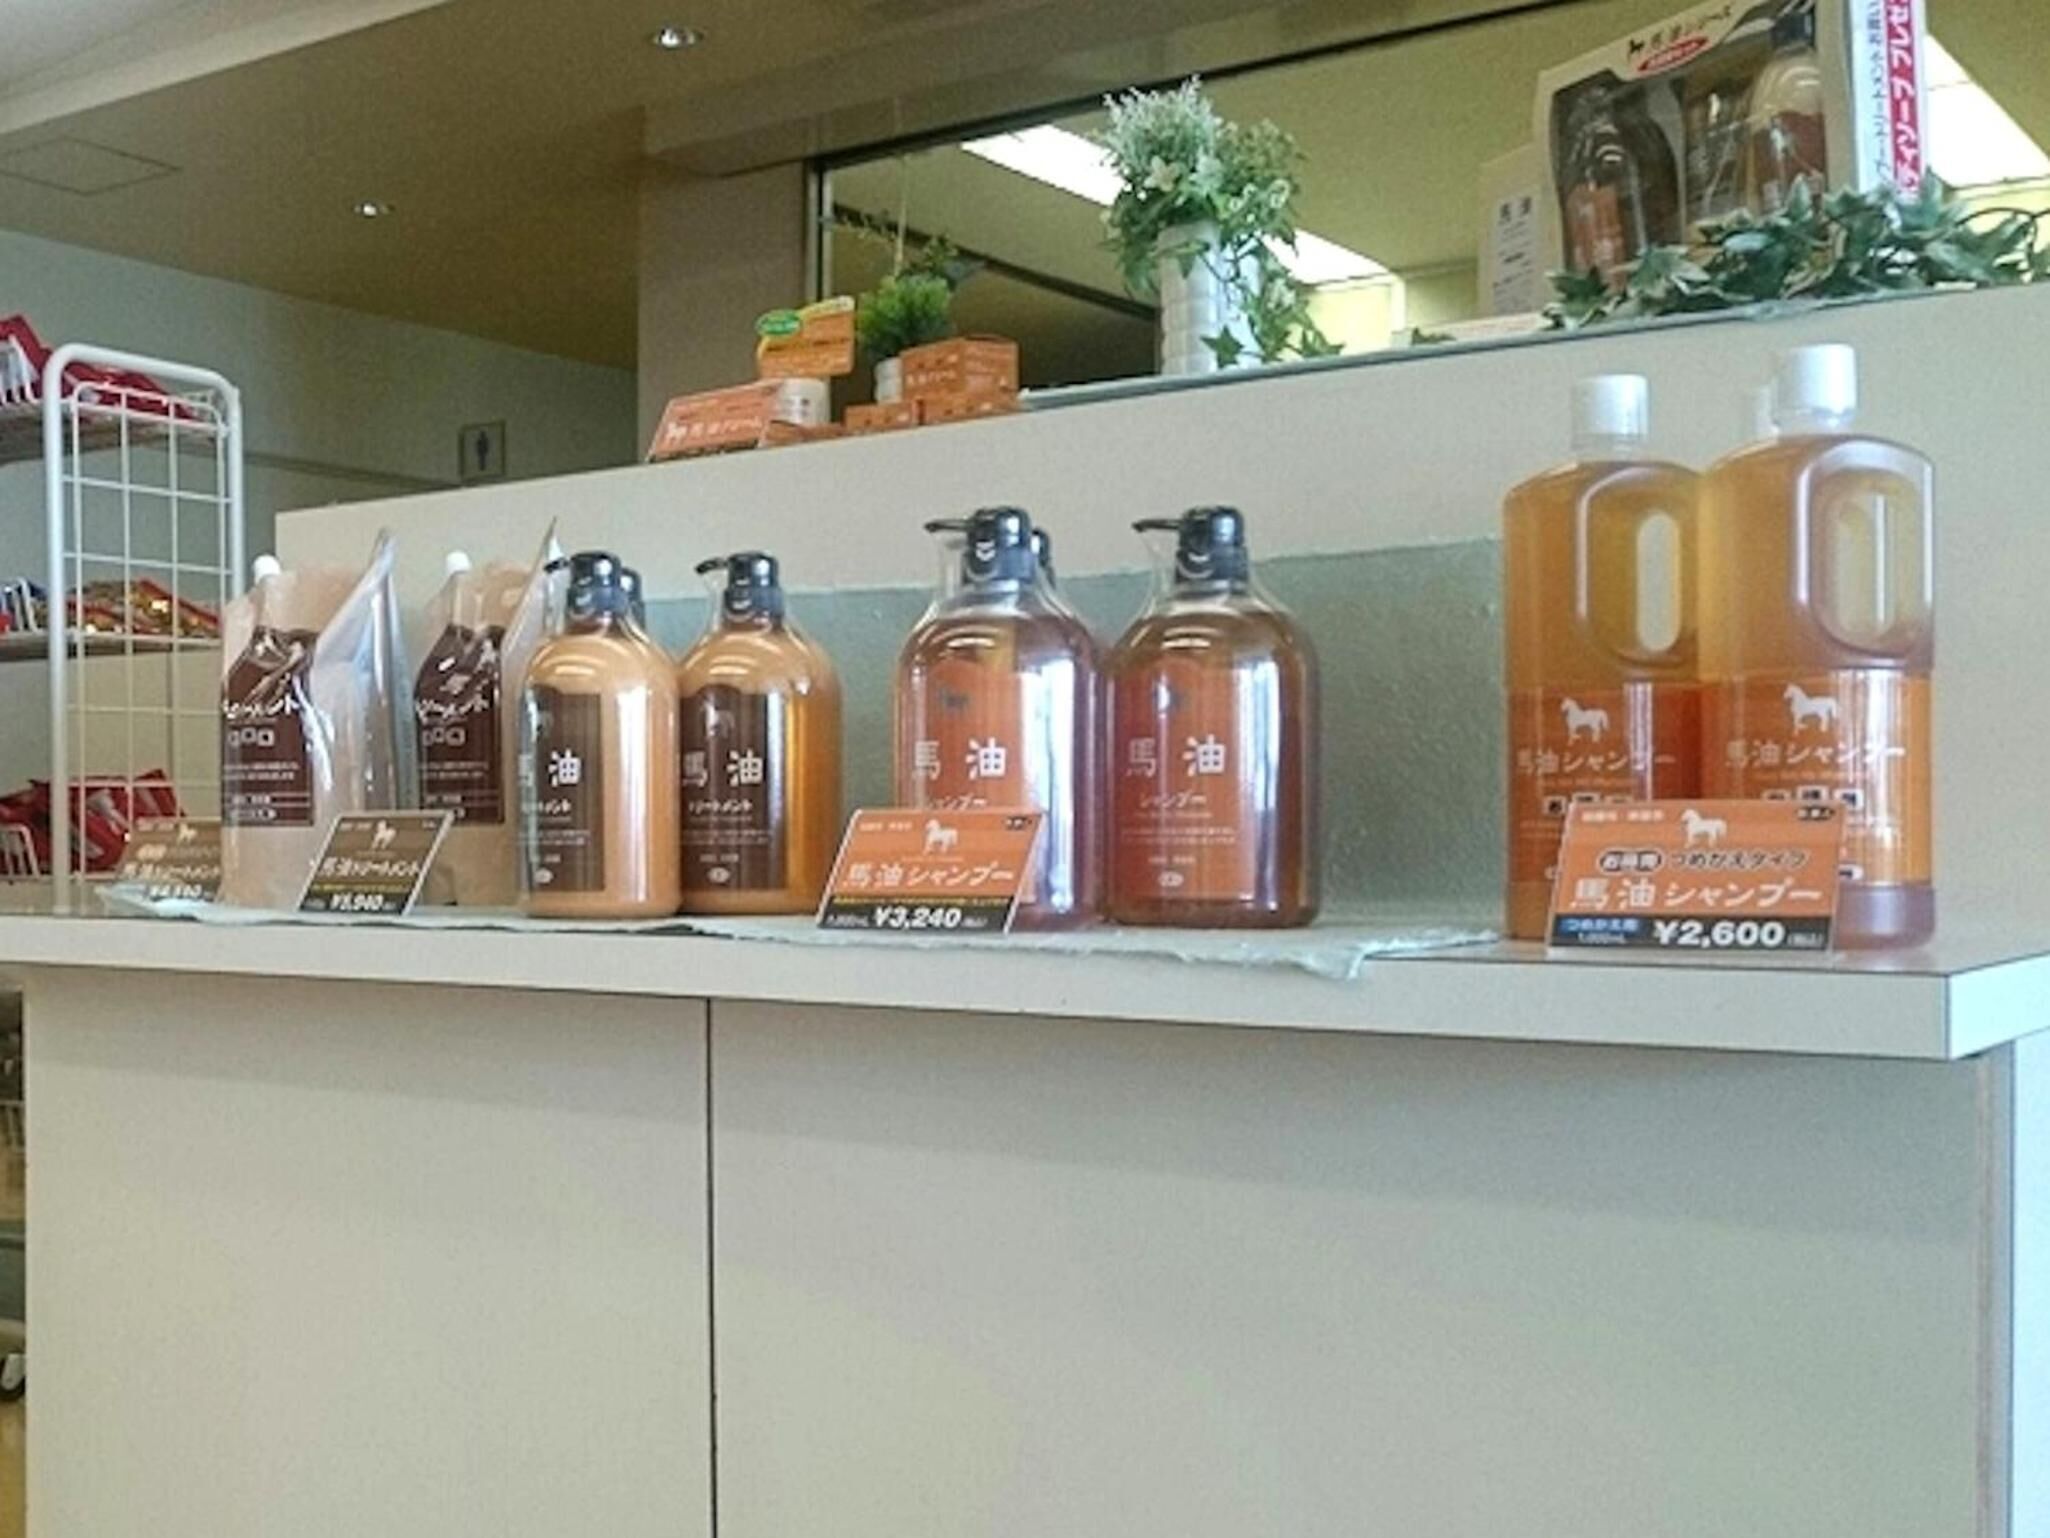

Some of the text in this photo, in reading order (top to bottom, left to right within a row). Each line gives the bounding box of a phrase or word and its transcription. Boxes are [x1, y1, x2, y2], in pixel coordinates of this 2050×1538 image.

[1887, 0, 1913, 69] プレゼ
[1125, 733, 1226, 778] 馬油
[842, 860, 1014, 887] 馬油シャンプー
[1569, 877, 1823, 909] 馬油シャンプー
[873, 906, 962, 930] ¥3,240
[1653, 919, 1786, 947] ¥2,600
